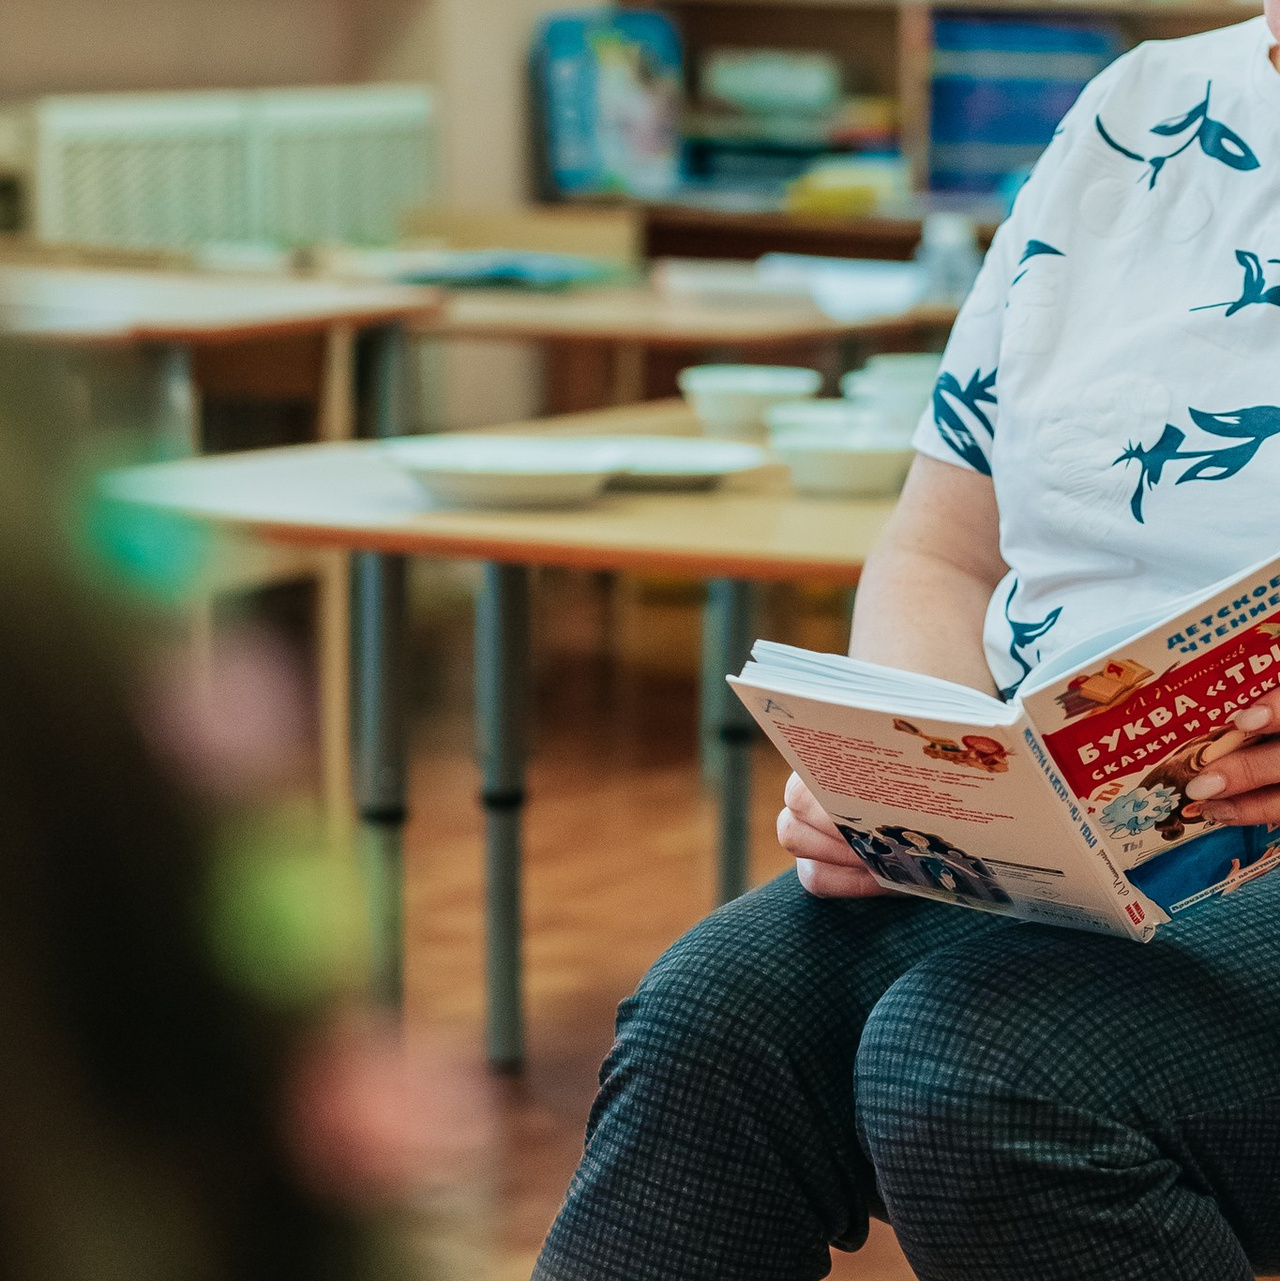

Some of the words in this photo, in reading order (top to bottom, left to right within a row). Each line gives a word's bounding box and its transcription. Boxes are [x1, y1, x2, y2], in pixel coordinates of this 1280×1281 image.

[1077, 694, 1199, 765] БУКВА
[1091, 731, 1178, 781] СКАЗКИ
[1184, 719, 1200, 732] И
[1094, 782, 1124, 803] ТЫ
[1080, 822, 1098, 849] БУКВА
[1171, 877, 1236, 912] Произведения
